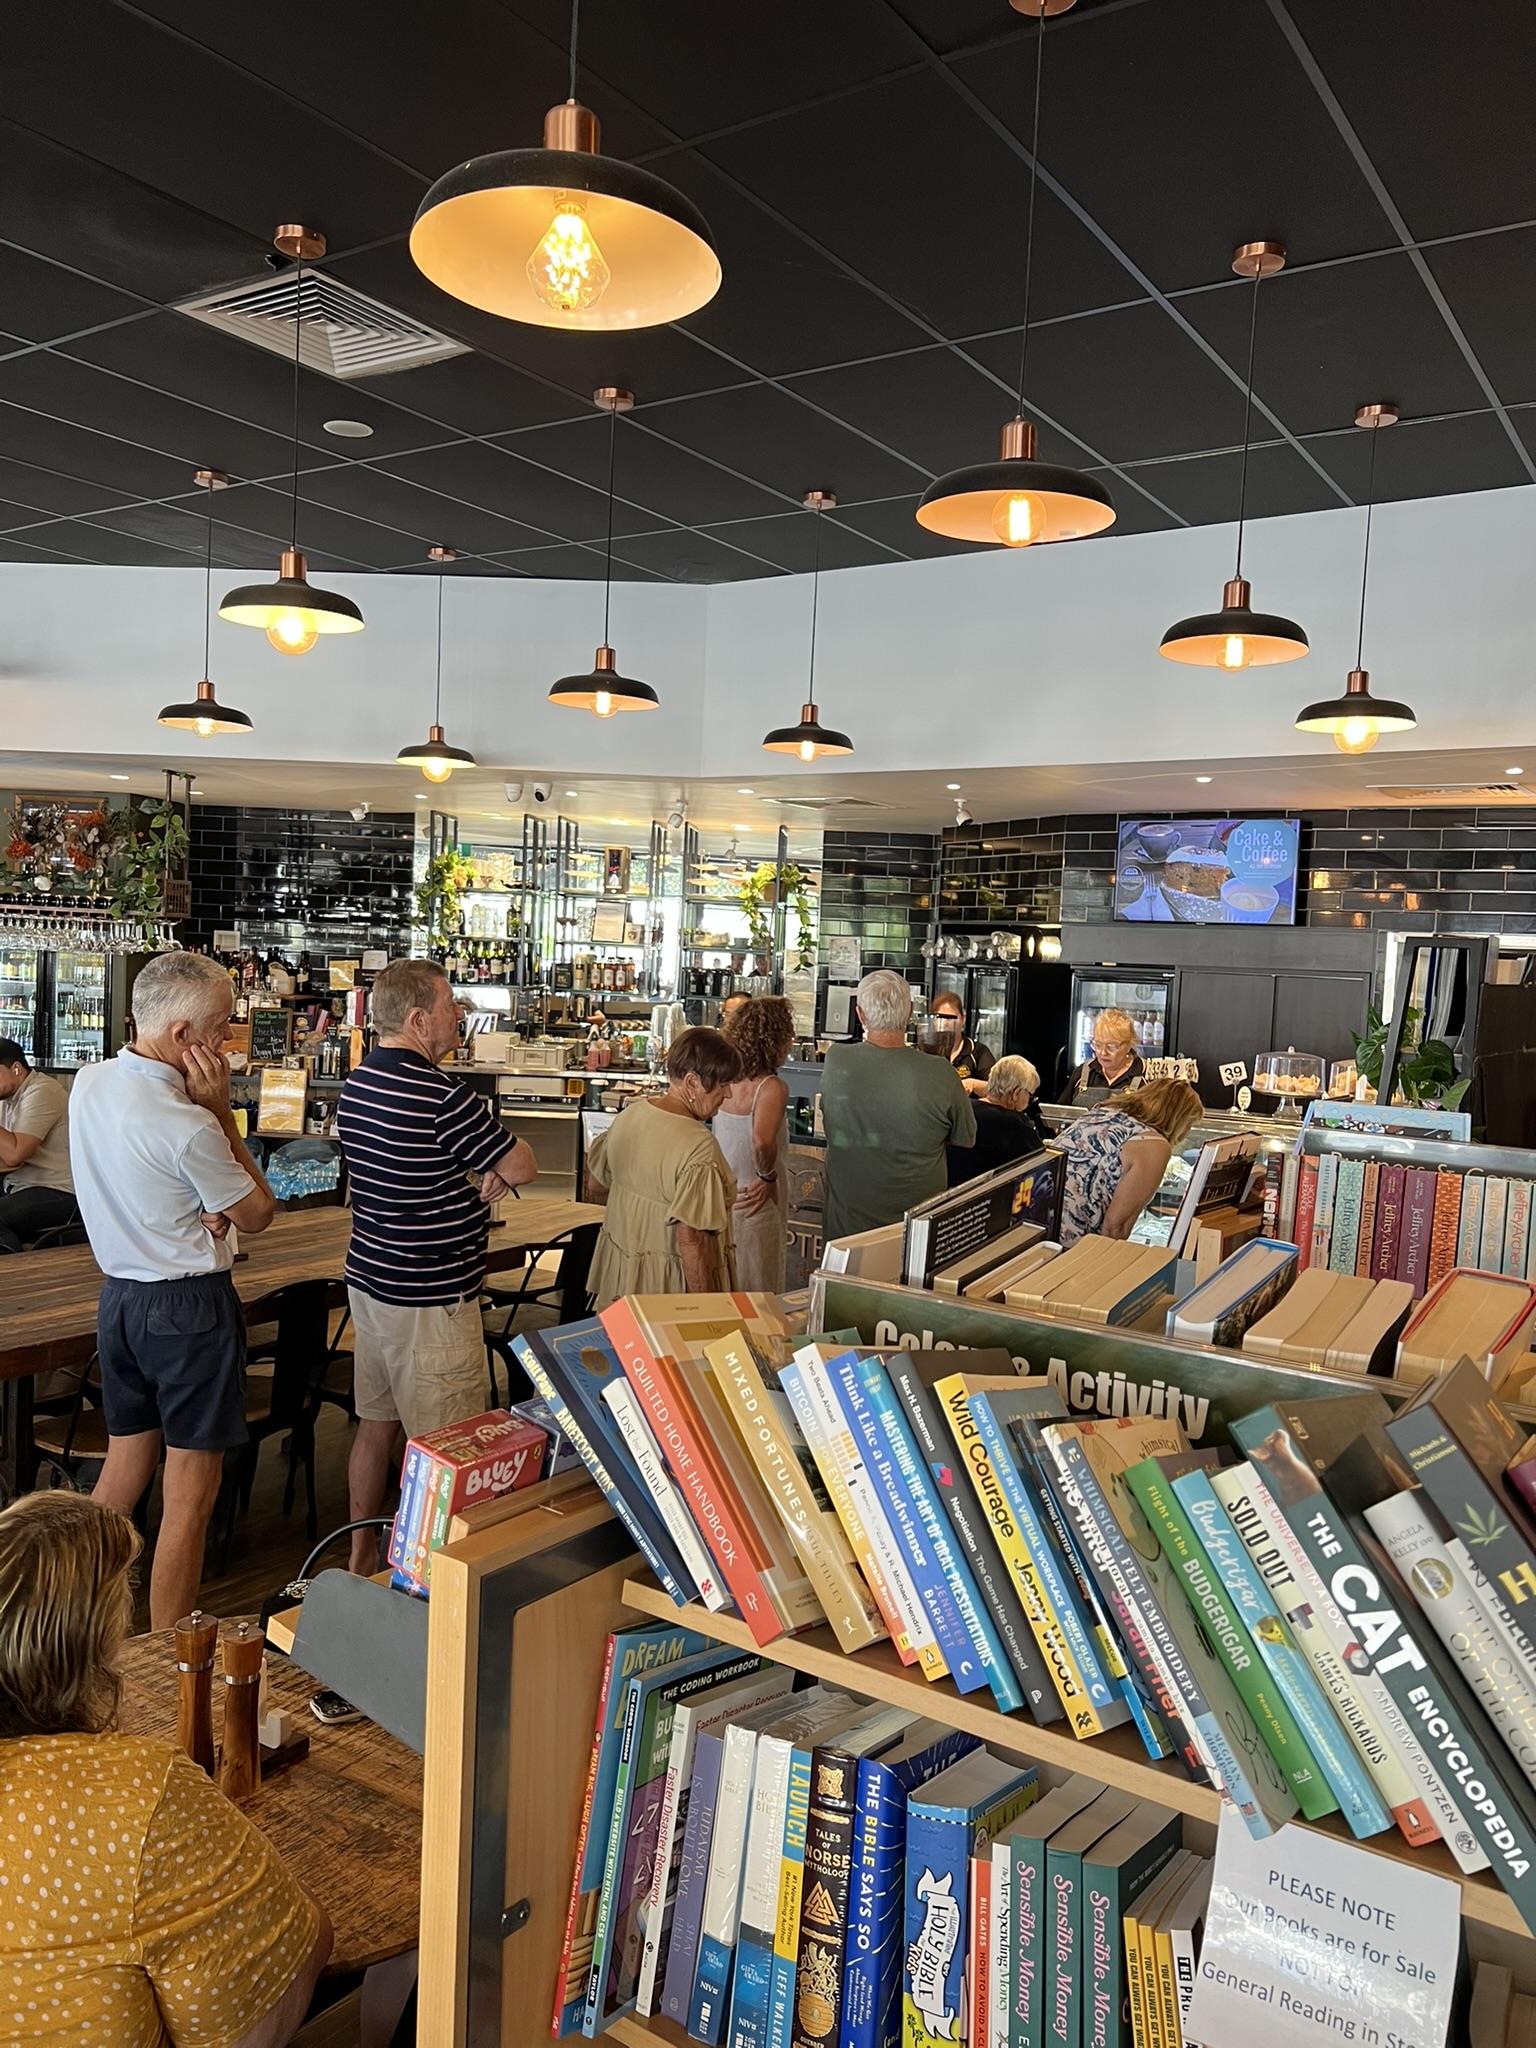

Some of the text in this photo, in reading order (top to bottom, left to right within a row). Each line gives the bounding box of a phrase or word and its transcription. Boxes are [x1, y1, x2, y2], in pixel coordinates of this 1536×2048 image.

[1234, 828, 1284, 847] Cake &
[1241, 844, 1288, 863] Coffee
[253, 1044, 272, 1059] Doggy
[254, 1026, 275, 1036] Check
[1173, 1064, 1180, 1079] 2
[1224, 1065, 1242, 1081] 39
[1300, 1175, 1309, 1216] ALEXANDER
[1307, 1184, 1315, 1209] NICOLE
[807, 1360, 837, 1424] Two Beats Ahead
[1047, 1357, 1209, 1440] Activity
[556, 1407, 599, 1467] BAREFOOT
[616, 1405, 668, 1497] Lost Found
[632, 1356, 670, 1422] QUILTED
[663, 1421, 693, 1472] HOME
[687, 1470, 739, 1567] HANDBOOK
[724, 1351, 807, 1522] MIXED FORTUNES
[789, 1377, 866, 1542] BITCOIN EVERYONE
[839, 1362, 865, 1411] Think
[857, 1411, 879, 1447] Like
[878, 1459, 928, 1567] Breadwinner
[1412, 1444, 1458, 1471] Christiansen
[466, 1450, 528, 1492] BLUEY
[879, 1410, 996, 1667] MASTERING OF PRESENTATIONS
[899, 1374, 1029, 1671] Max Bazerman Negotiation The Has Changed
[949, 1390, 1084, 1698] Wild Courage Jenny Wood
[974, 1400, 1086, 1648] HOW THRIVE THE VIRTUAL WORKPLACE ROBERT
[1388, 1523, 1425, 1546] ANGELA
[1077, 1467, 1125, 1556] WHIMSICAL
[1121, 1556, 1147, 1596] FELT
[1141, 1599, 1201, 1703] EMBROIDERY
[1148, 1485, 1252, 1672] Flight of the BUDGERIGAR
[1191, 1499, 1262, 1612] Budgerigar
[923, 1589, 956, 1649] BARRETT
[934, 1584, 966, 1647] JENNIFER
[1227, 1495, 1271, 1548] SOLD
[1256, 1548, 1296, 1590] OUT
[1314, 1651, 1349, 1695] JAMES
[1339, 1695, 1388, 1765] RICKARDS
[1458, 1599, 1499, 1653] THE
[622, 1637, 686, 1678] DREAM
[663, 1657, 760, 1701] THE CODING WORKBOOK
[1270, 1510, 1459, 1824] UNIVERSE BOX ANDREW PONTZEN
[1306, 1512, 1343, 1559] THE
[1331, 1564, 1427, 1675] CAT
[1407, 1685, 1531, 1879] ENCYCLOPEDIA
[1203, 1731, 1238, 1790] THOMPSON
[1213, 1731, 1243, 1784] MEGHAN
[1292, 1768, 1311, 1782] NLA
[650, 1765, 679, 1907] Faster Disaster Recovery
[786, 1762, 811, 1849] LAUNCH
[815, 1828, 841, 1844] TALES
[589, 1727, 633, 2002] WORKBOOK BUILD WITH HTML TAYLOR
[677, 1790, 701, 1899] ABOUT LOVE
[694, 1805, 713, 1877] JUDAISM
[806, 1843, 851, 1869] NORSE
[857, 1774, 881, 1951] THE BIBLE SAYS SO
[927, 1904, 949, 1954] HOLY
[978, 1917, 988, 1947] GATES
[997, 1881, 1011, 1968] Art Spending
[1268, 1870, 1396, 1931] PLEASE NOTE
[672, 1915, 684, 1952] HELD
[683, 1922, 695, 1957] SHAI
[978, 1952, 987, 1976] HOW
[1015, 1860, 1037, 2025] Sensible Money
[1052, 1874, 1073, 2042] Sensible Money
[1089, 1889, 1111, 1980] Sensible
[1264, 1906, 1437, 1985] Books are for Sale
[918, 1949, 940, 2001] BIBLE
[1129, 1949, 1142, 2012] YOU CAN ALWAYS
[1144, 1956, 1157, 2020] YOU CAN ALWAYS
[1161, 1964, 1174, 2028] YOU CAN ALWAYS
[1178, 1957, 1192, 1981] THE
[771, 1968, 788, 2048] JEFF WALKER
[977, 1993, 986, 2025] AVOID
[1202, 1960, 1379, 2046] General Reading in
